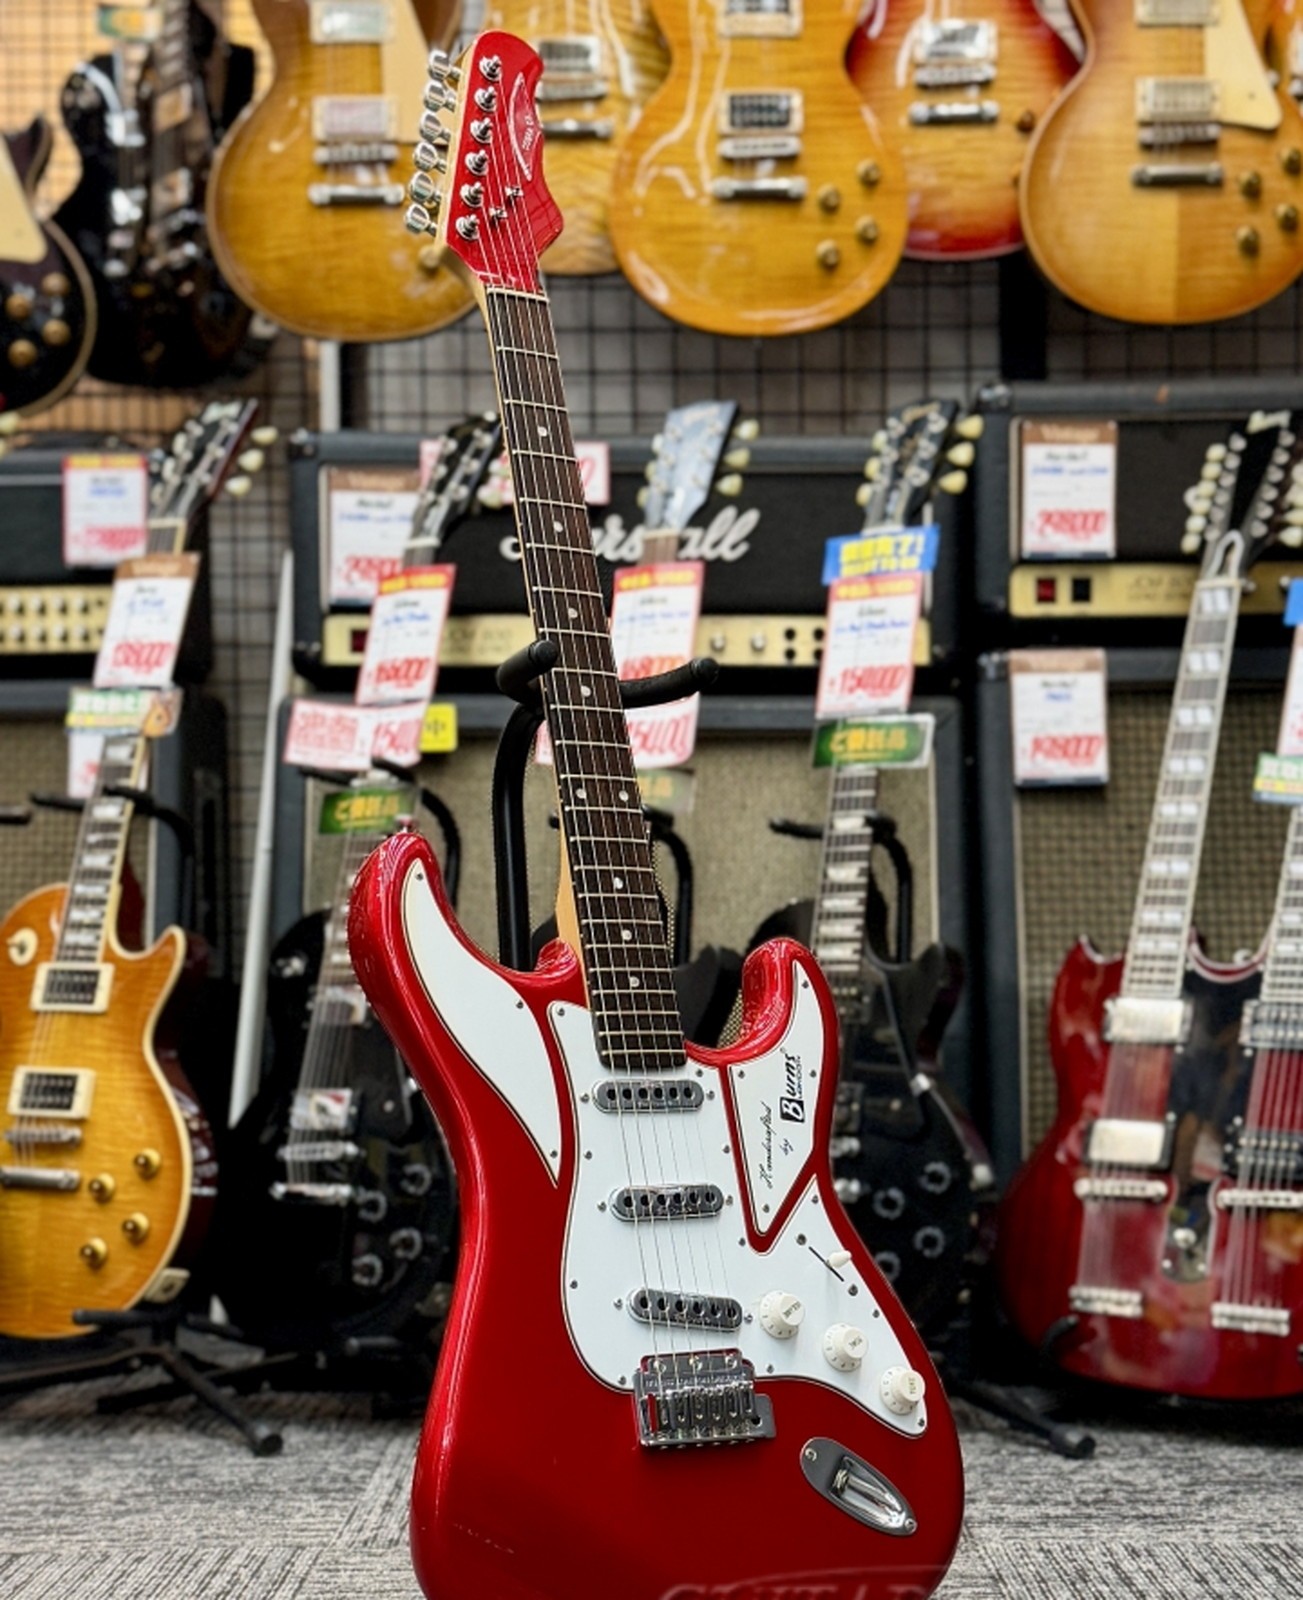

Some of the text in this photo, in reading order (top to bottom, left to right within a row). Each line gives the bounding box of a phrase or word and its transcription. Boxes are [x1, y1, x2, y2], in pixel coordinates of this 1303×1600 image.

[779, 1053, 805, 1124] Burns
[758, 1100, 777, 1190] Handcrafted
[779, 1137, 794, 1156] by
